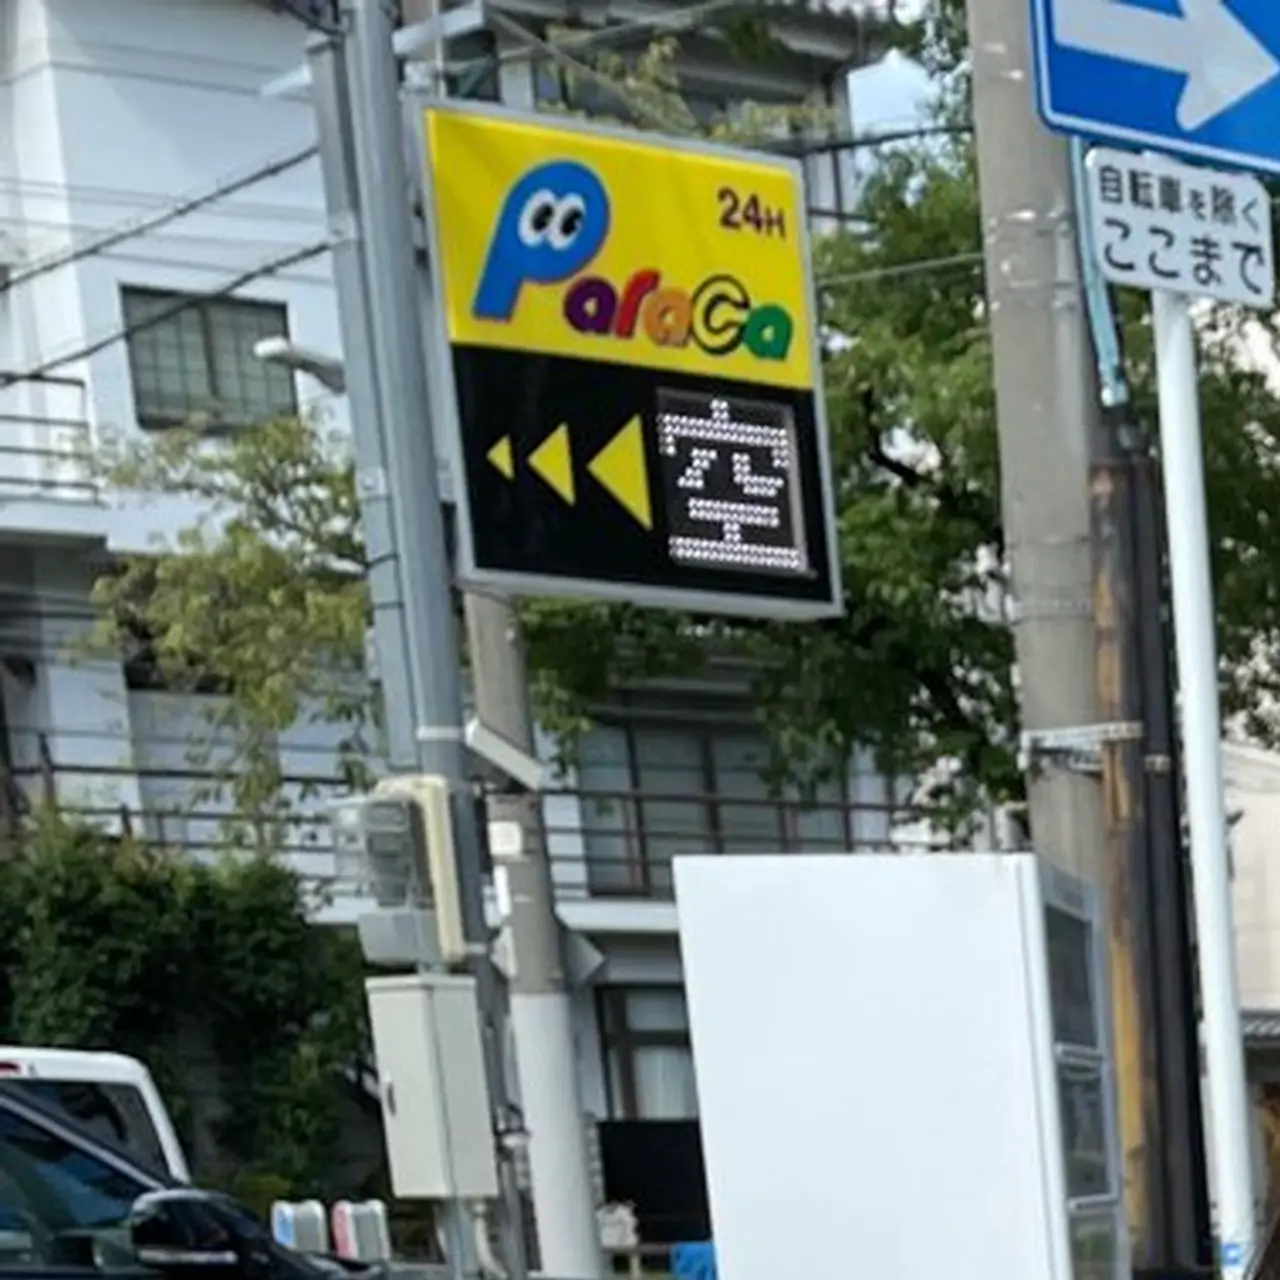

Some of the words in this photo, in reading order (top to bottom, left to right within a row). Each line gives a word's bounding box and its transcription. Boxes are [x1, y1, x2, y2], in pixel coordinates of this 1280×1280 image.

[717, 187, 787, 239] 24H
[1100, 164, 1260, 232] 自転車を除く
[1104, 217, 1266, 295] ここまで
[657, 398, 800, 567] 空
